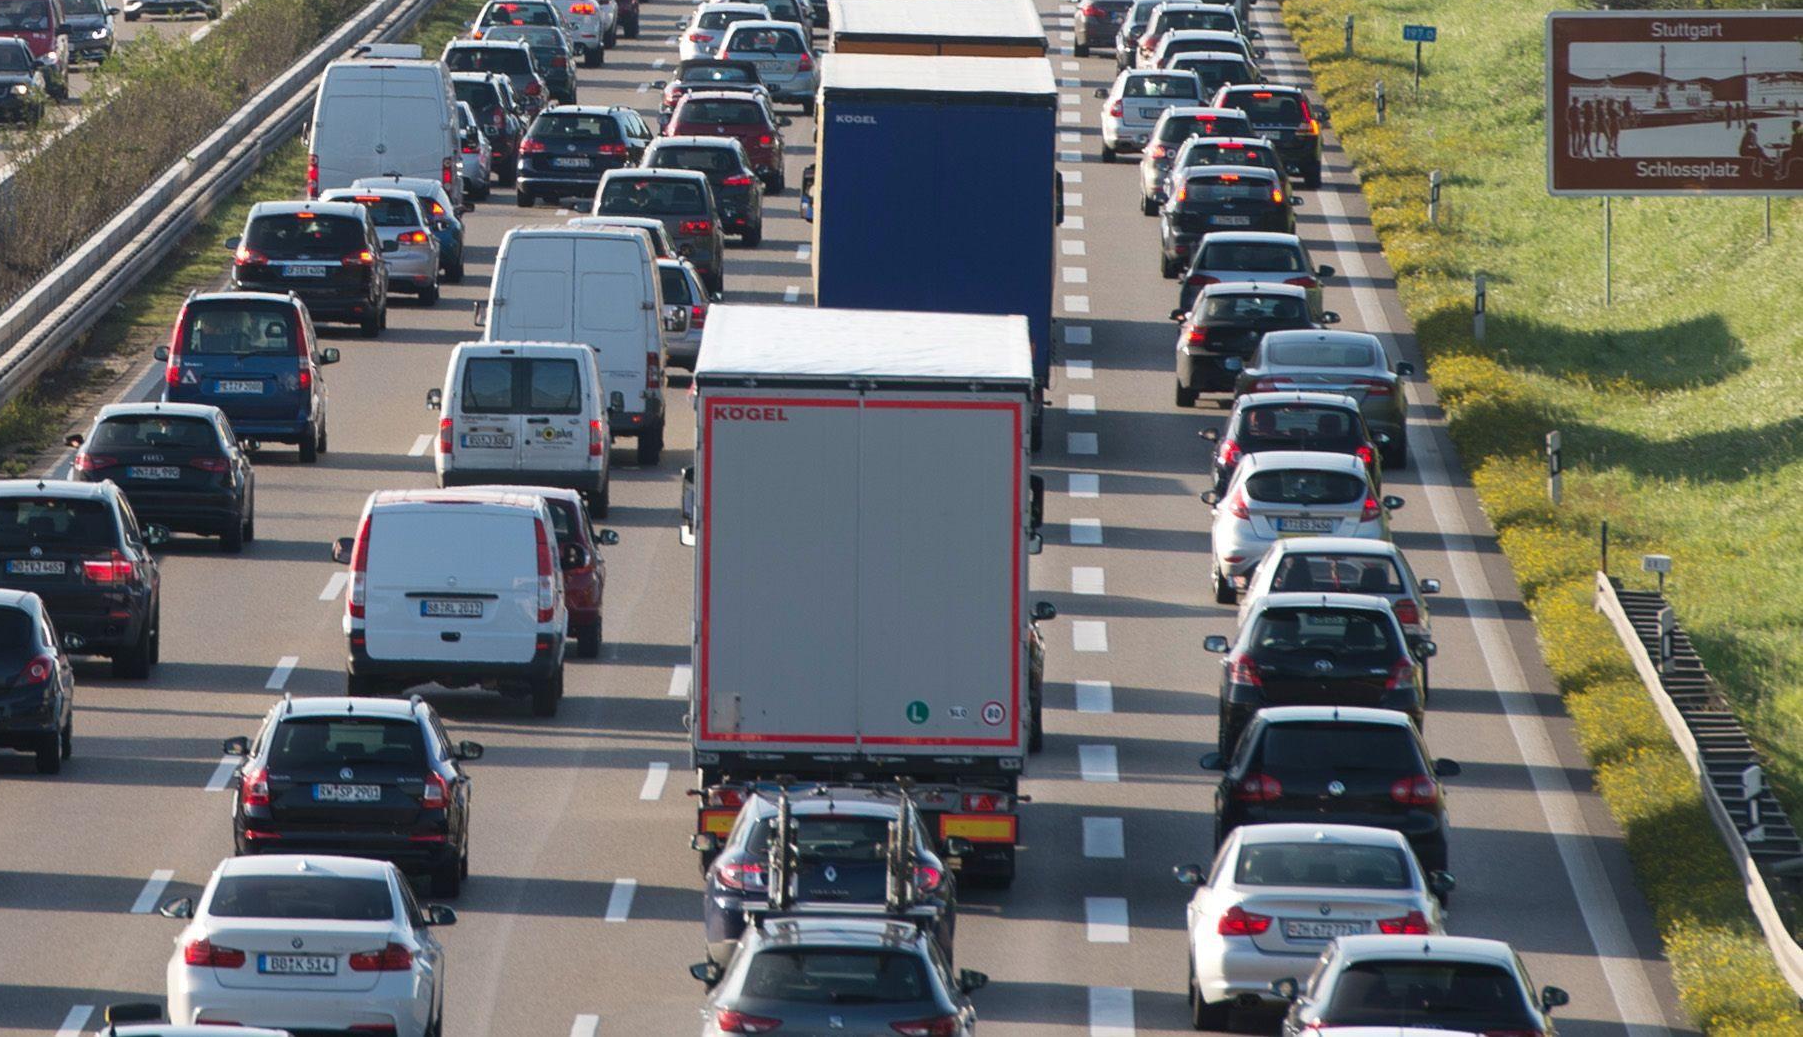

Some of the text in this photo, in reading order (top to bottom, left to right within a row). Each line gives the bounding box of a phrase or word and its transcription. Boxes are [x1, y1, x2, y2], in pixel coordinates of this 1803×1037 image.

[1651, 21, 1723, 40] Stuttgart
[1636, 161, 1740, 181] Schlossplatz
[713, 405, 788, 422] KÖGEL
[912, 704, 922, 721] L
[270, 957, 330, 970] BB K 514
